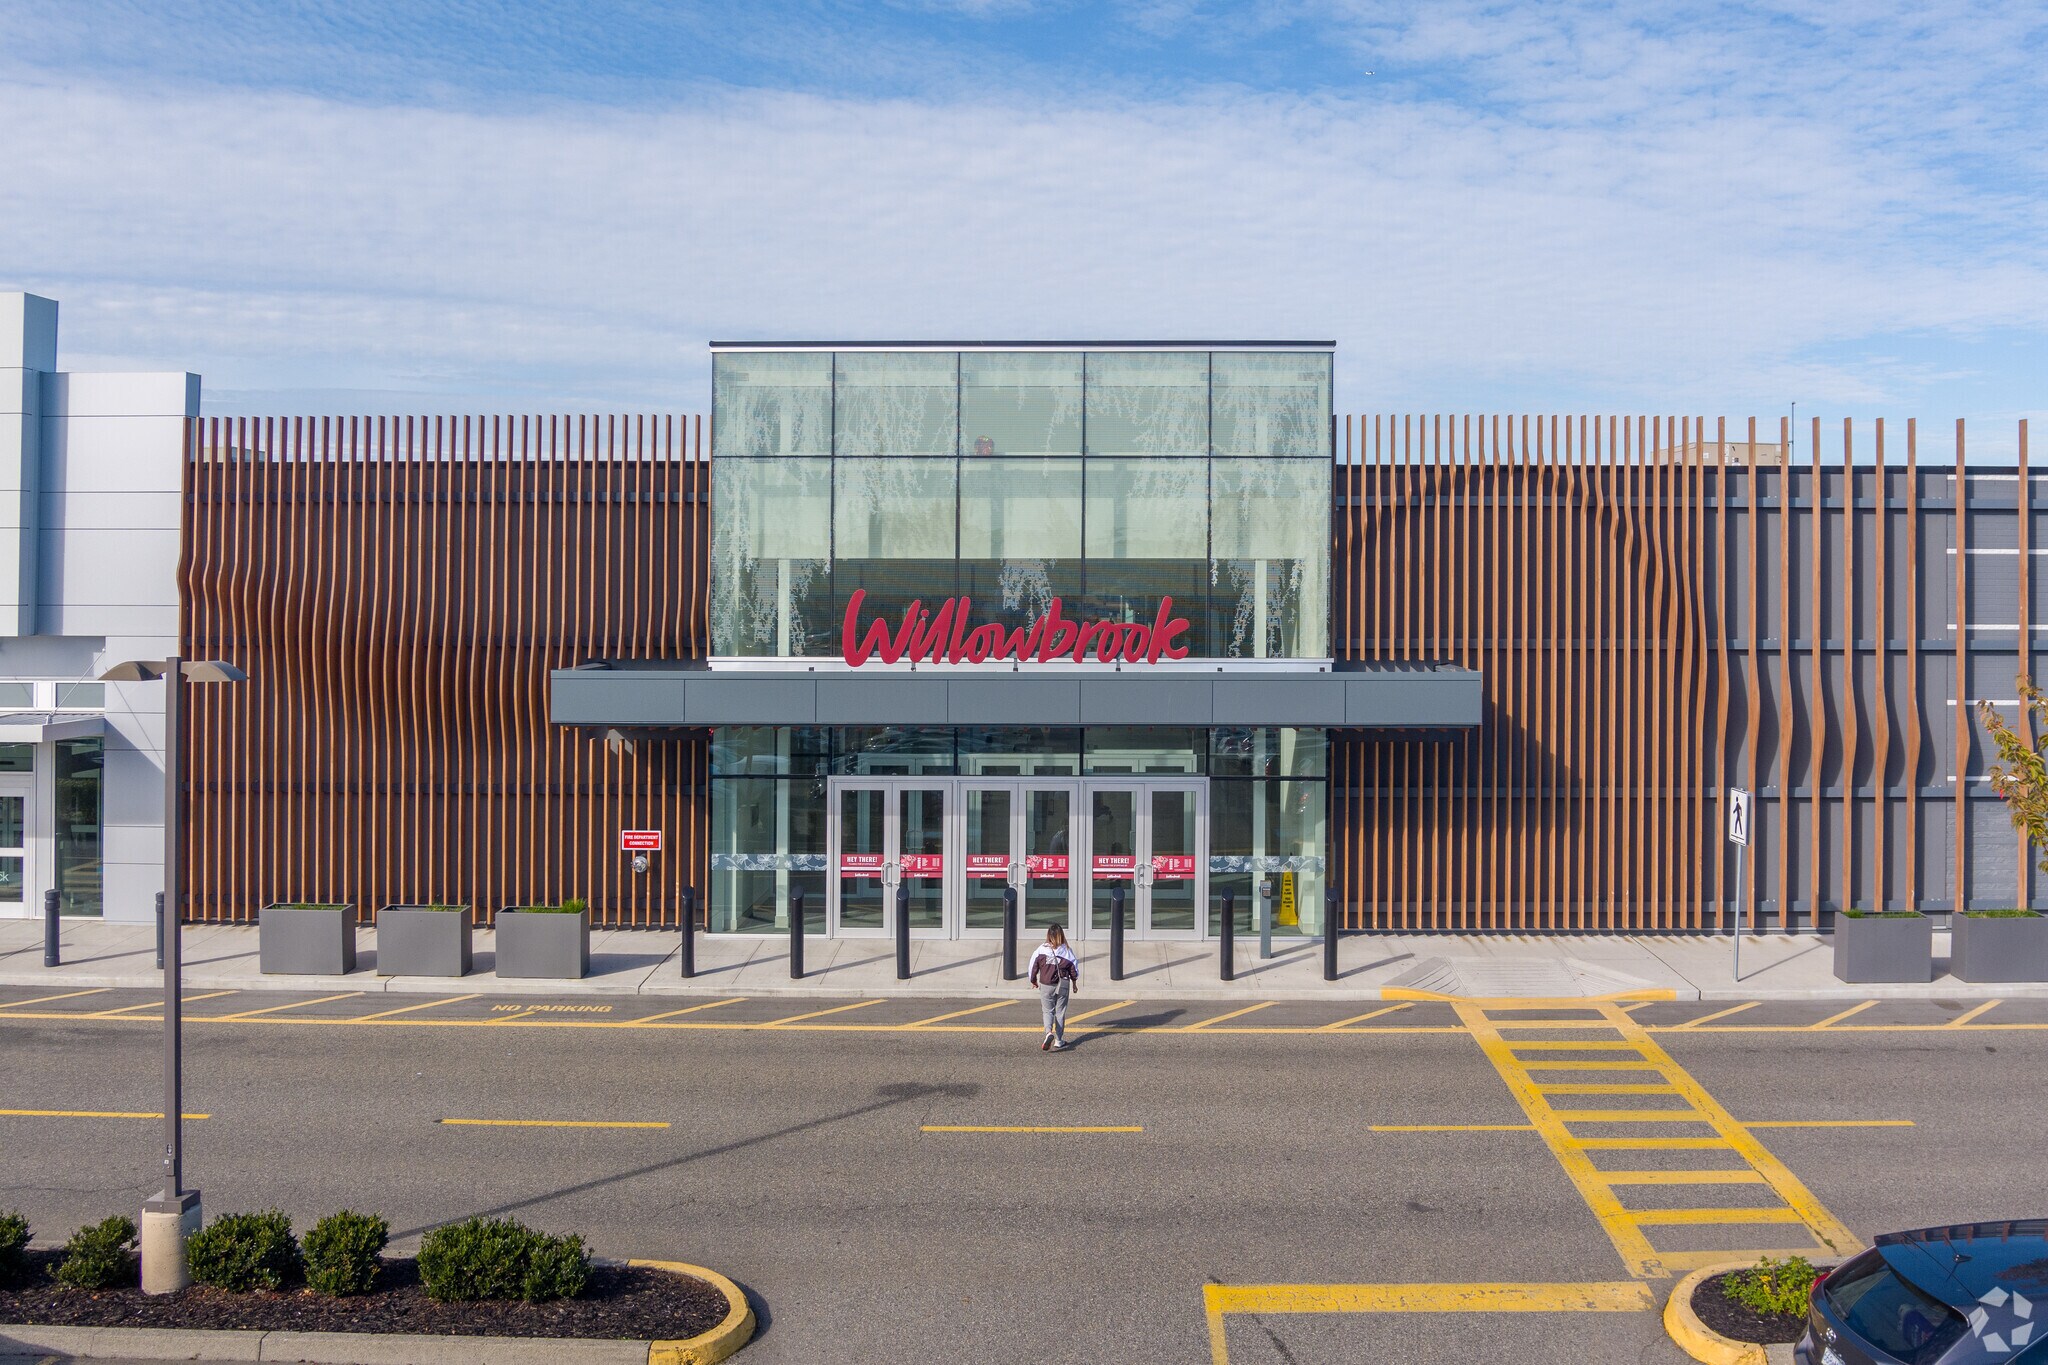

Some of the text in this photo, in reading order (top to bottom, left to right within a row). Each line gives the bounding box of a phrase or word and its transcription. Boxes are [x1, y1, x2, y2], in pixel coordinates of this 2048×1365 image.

[842, 588, 1190, 668] Willowbrook
[972, 856, 1004, 864] HEY THERE!
[526, 1005, 613, 1013] PARKING
